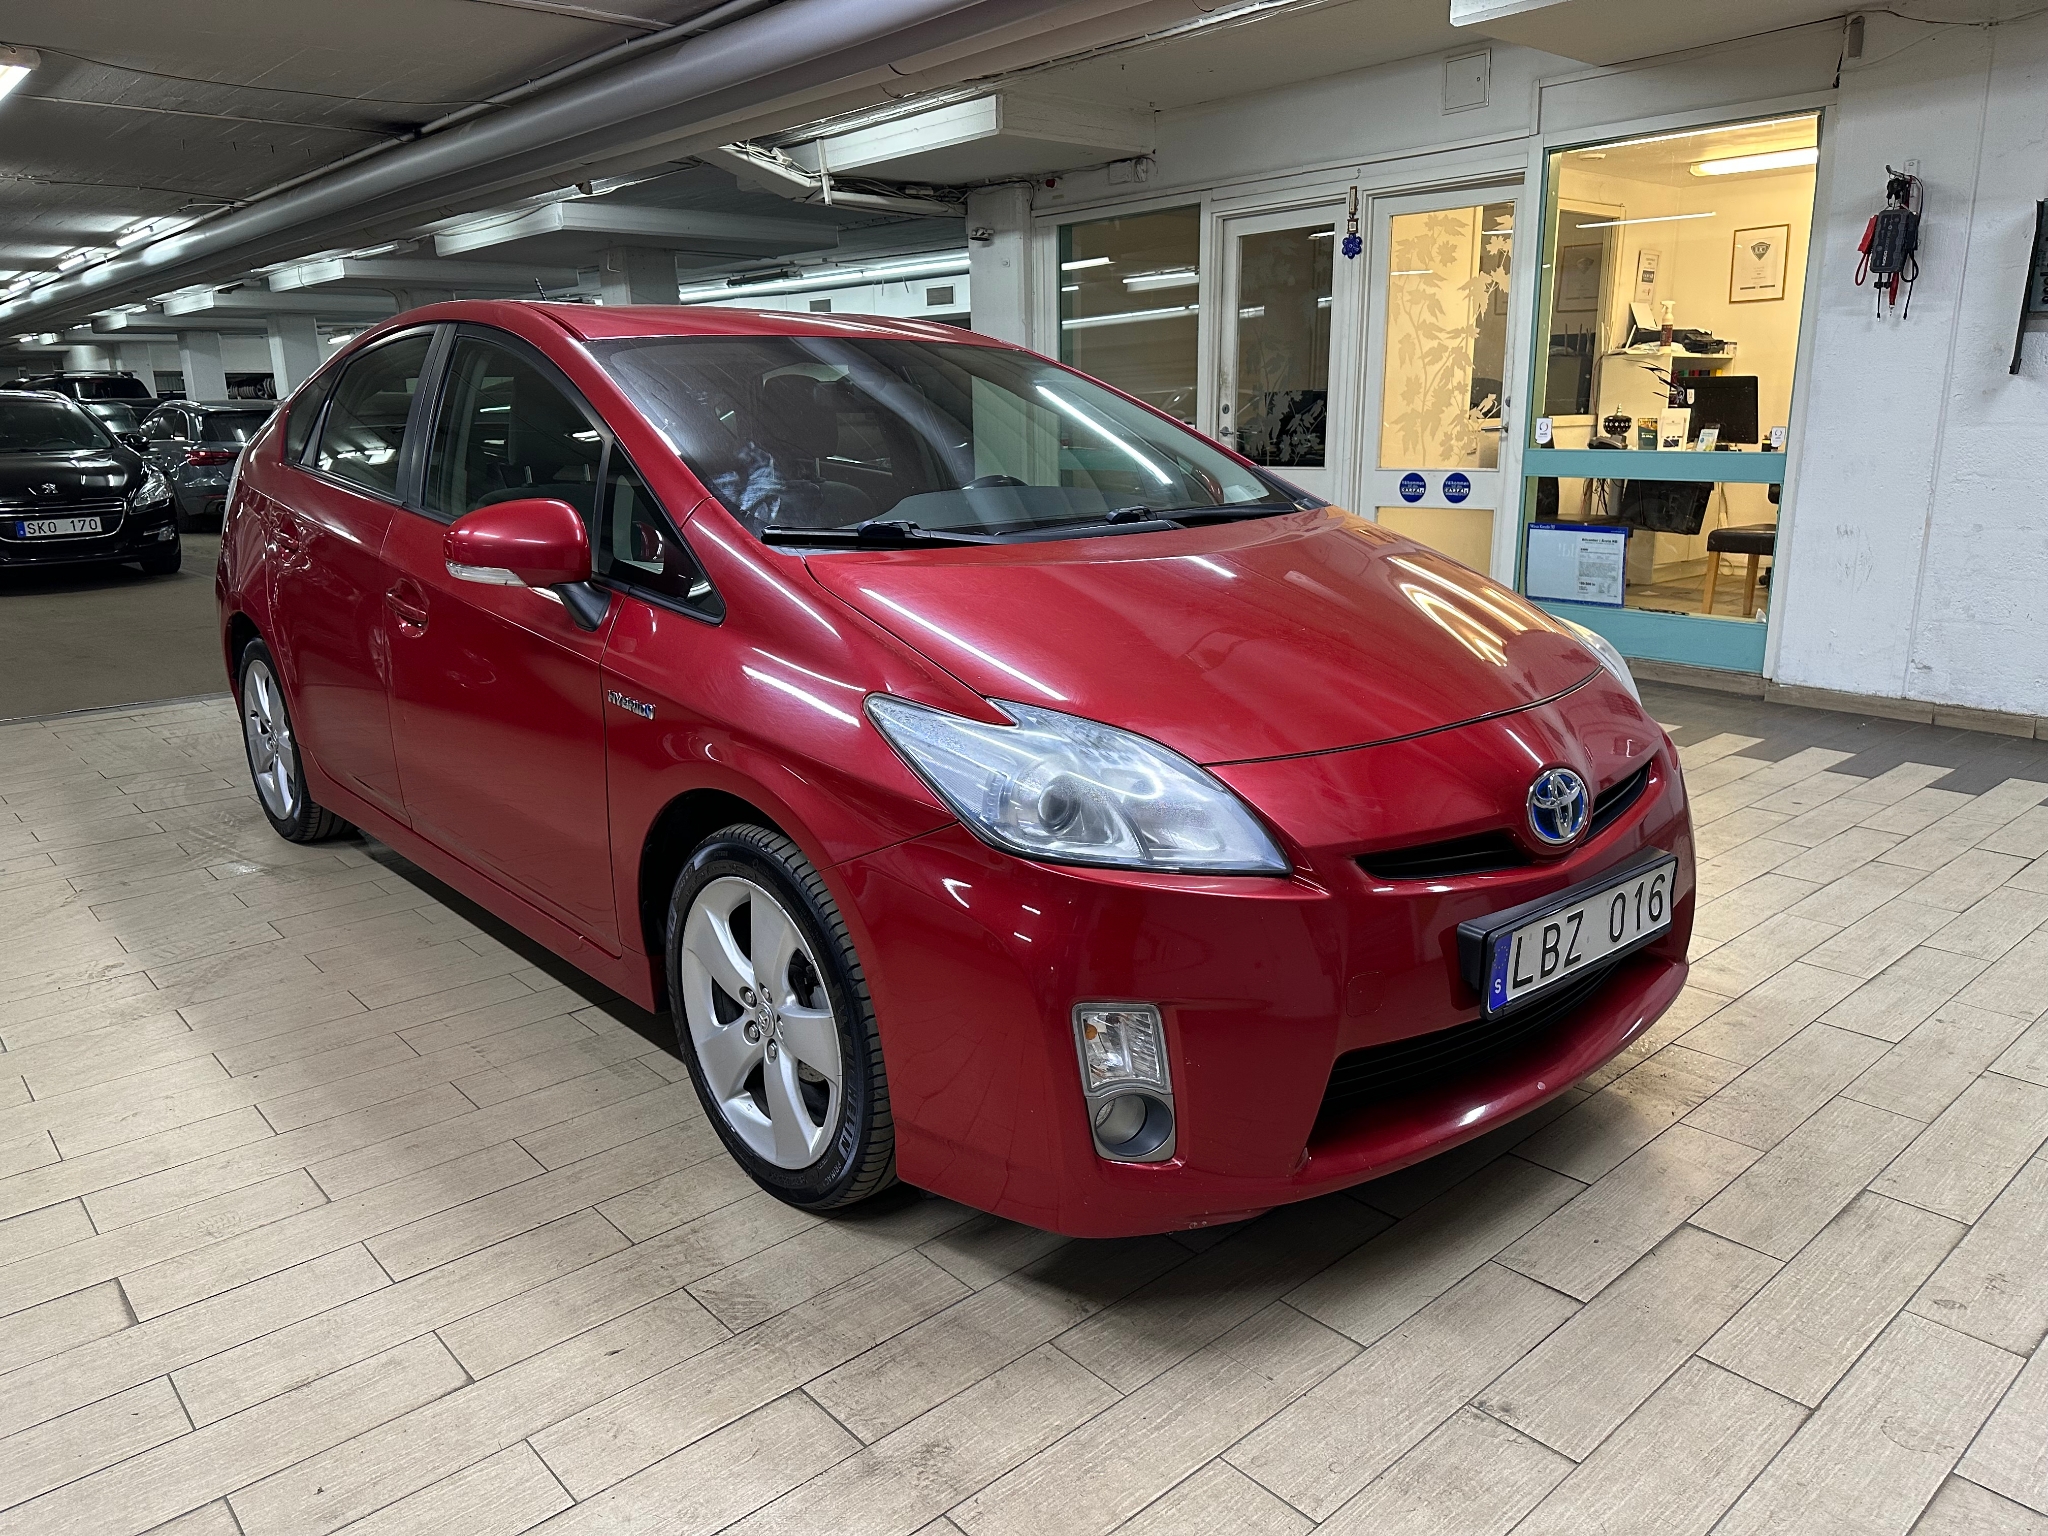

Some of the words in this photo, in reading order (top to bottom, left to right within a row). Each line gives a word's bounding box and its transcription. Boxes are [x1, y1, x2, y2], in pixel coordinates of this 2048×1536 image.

[27, 521, 57, 535] SKO
[70, 518, 98, 532] 170
[1512, 909, 1584, 990] LBZ
[1609, 873, 1666, 943] 016
[1494, 978, 1502, 994] S
